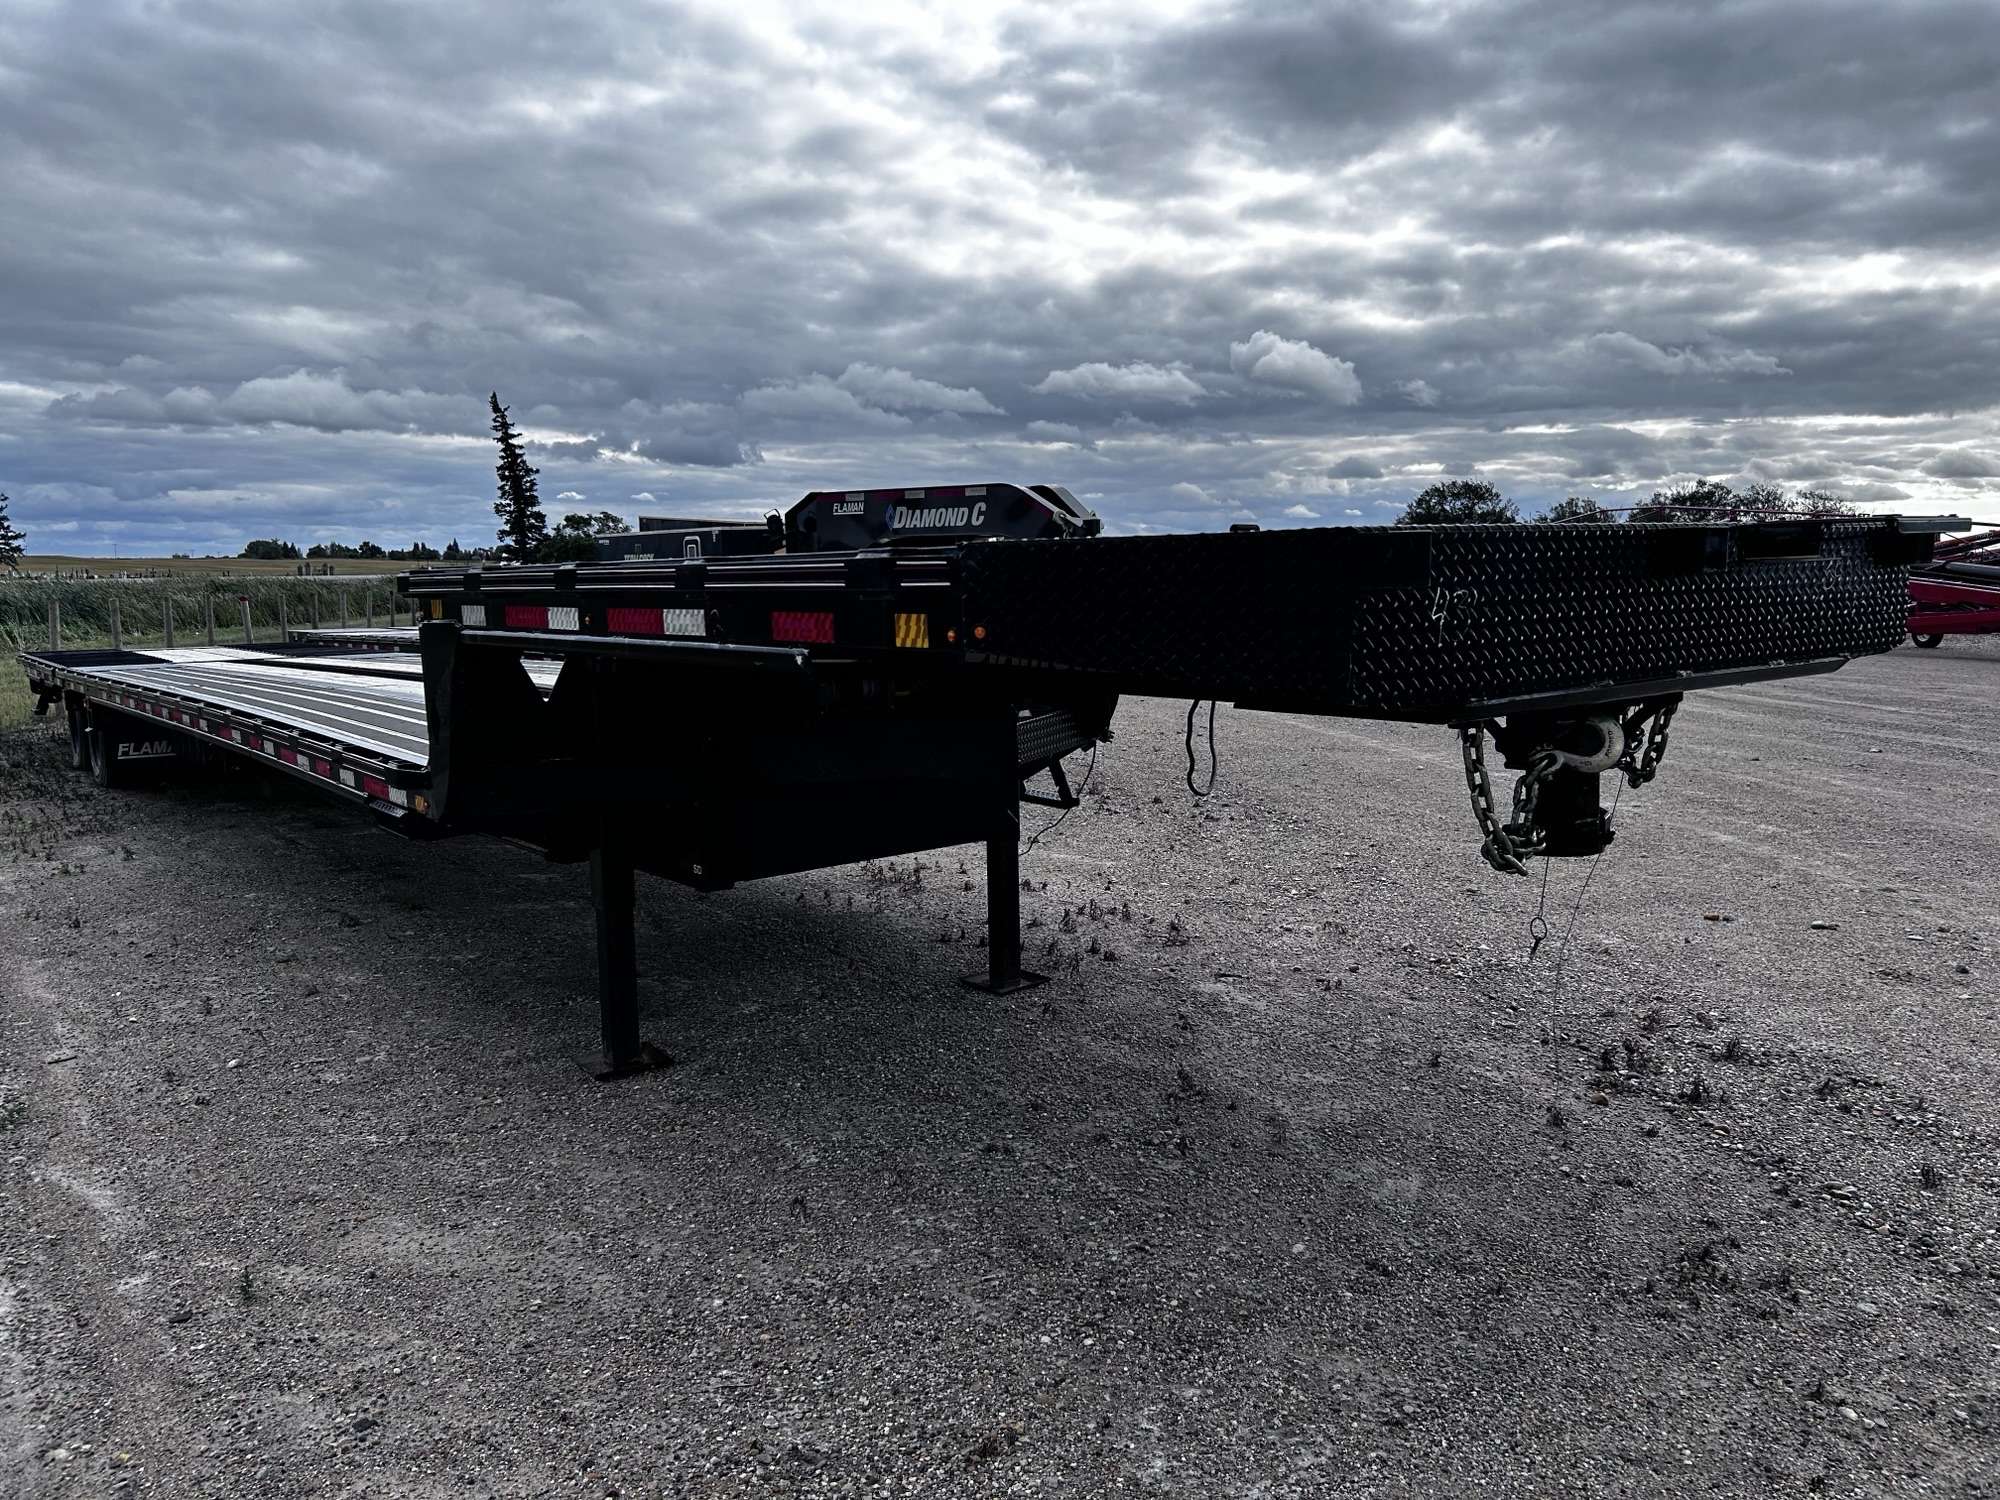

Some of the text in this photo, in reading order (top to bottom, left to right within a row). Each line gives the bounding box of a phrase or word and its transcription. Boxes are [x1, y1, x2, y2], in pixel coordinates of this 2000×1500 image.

[832, 501, 864, 513] FLAMAN
[893, 502, 987, 528] DIAMOND C
